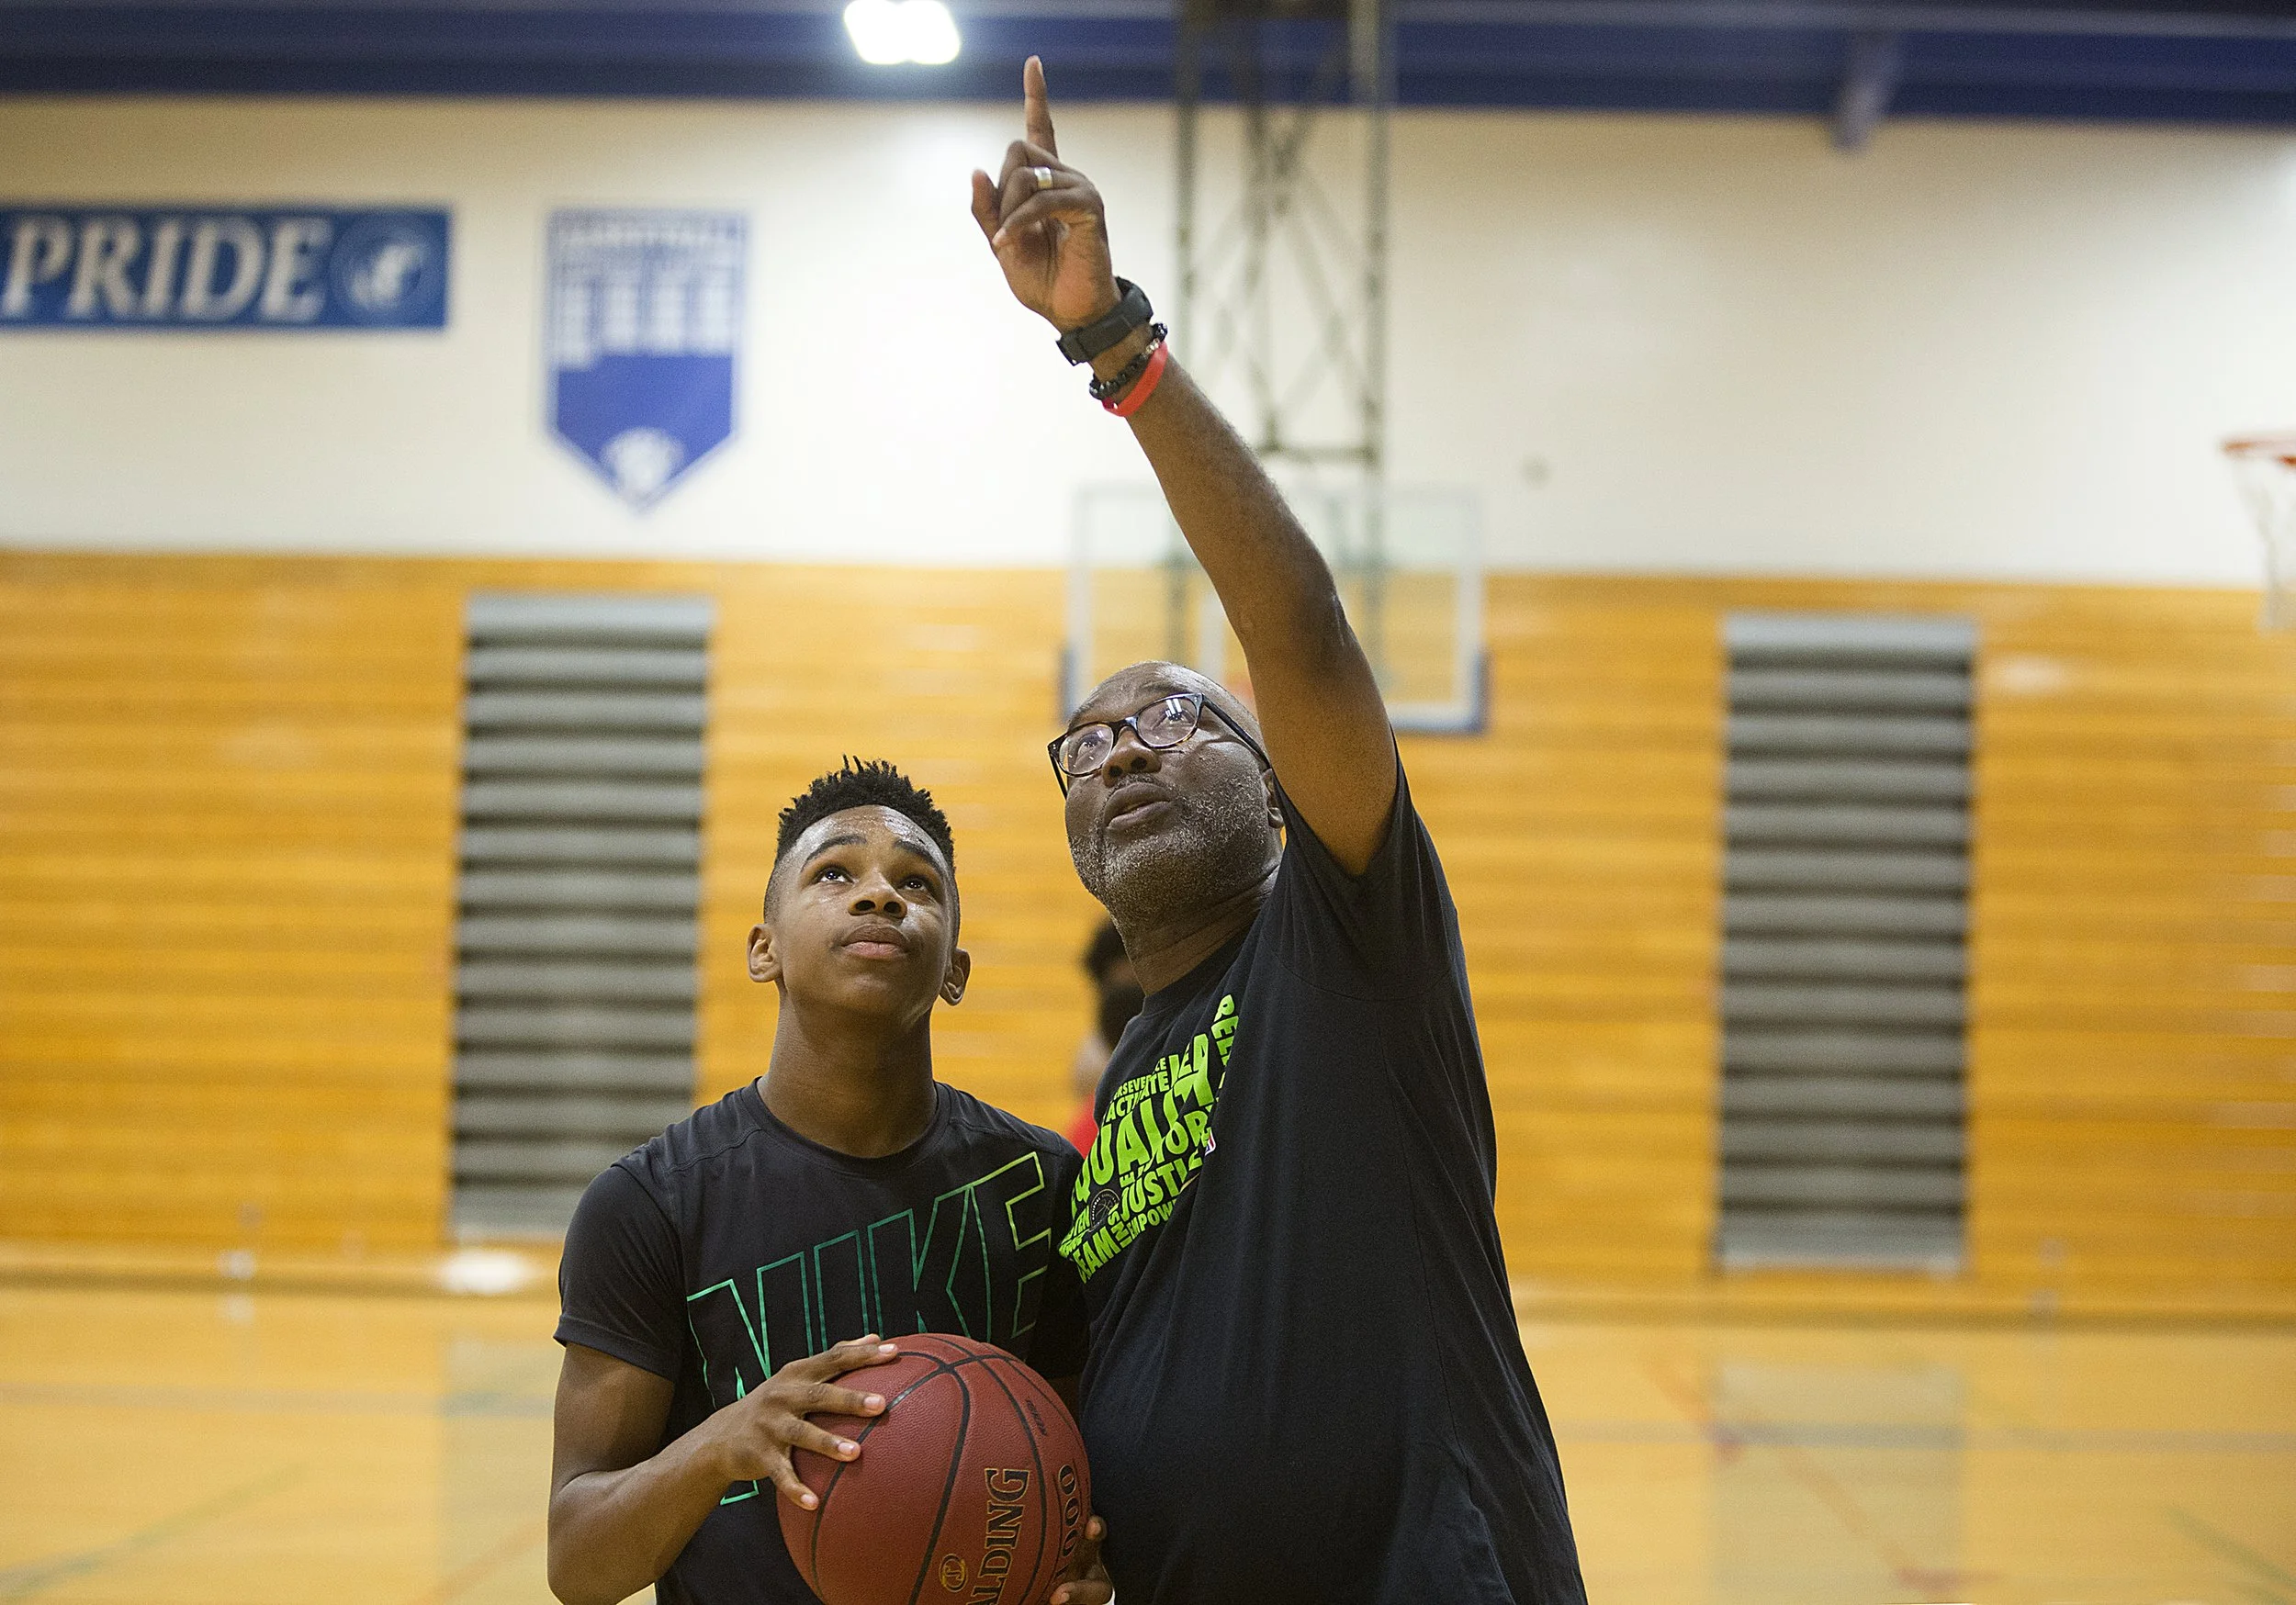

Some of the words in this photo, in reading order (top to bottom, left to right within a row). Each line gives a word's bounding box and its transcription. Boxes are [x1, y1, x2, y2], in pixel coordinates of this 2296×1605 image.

[2, 214, 332, 321] PRIDE
[1072, 1065, 1215, 1221] QUALITY
[1126, 1198, 1178, 1240] EMPOW
[687, 1151, 1052, 1505] NIKE
